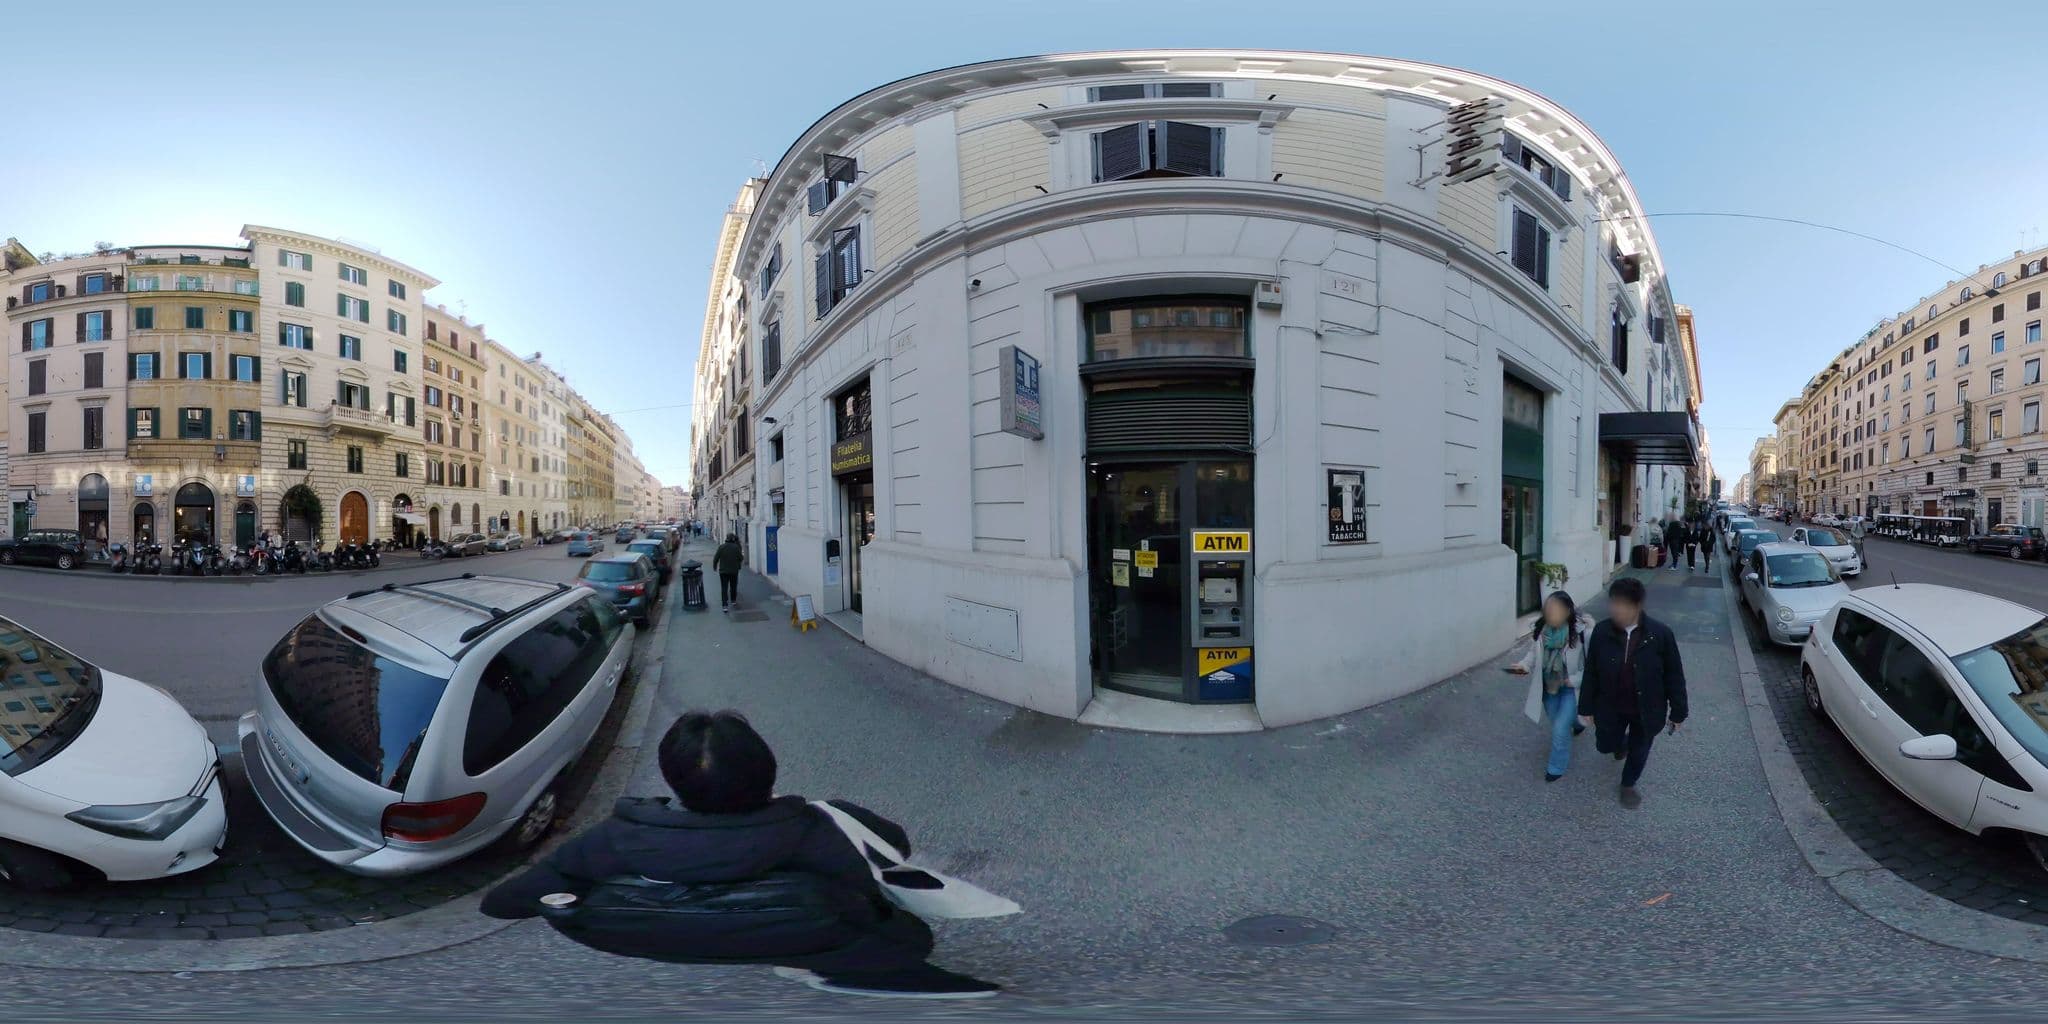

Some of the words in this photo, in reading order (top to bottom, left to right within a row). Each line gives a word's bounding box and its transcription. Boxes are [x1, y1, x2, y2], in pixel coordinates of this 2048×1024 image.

[837, 440, 863, 456] Filatelia
[832, 453, 871, 471] Numismatica
[1335, 524, 1353, 532] SALI
[1331, 532, 1364, 540] TABACCHI
[1203, 536, 1242, 550] ATM
[1206, 650, 1238, 660] ATM
